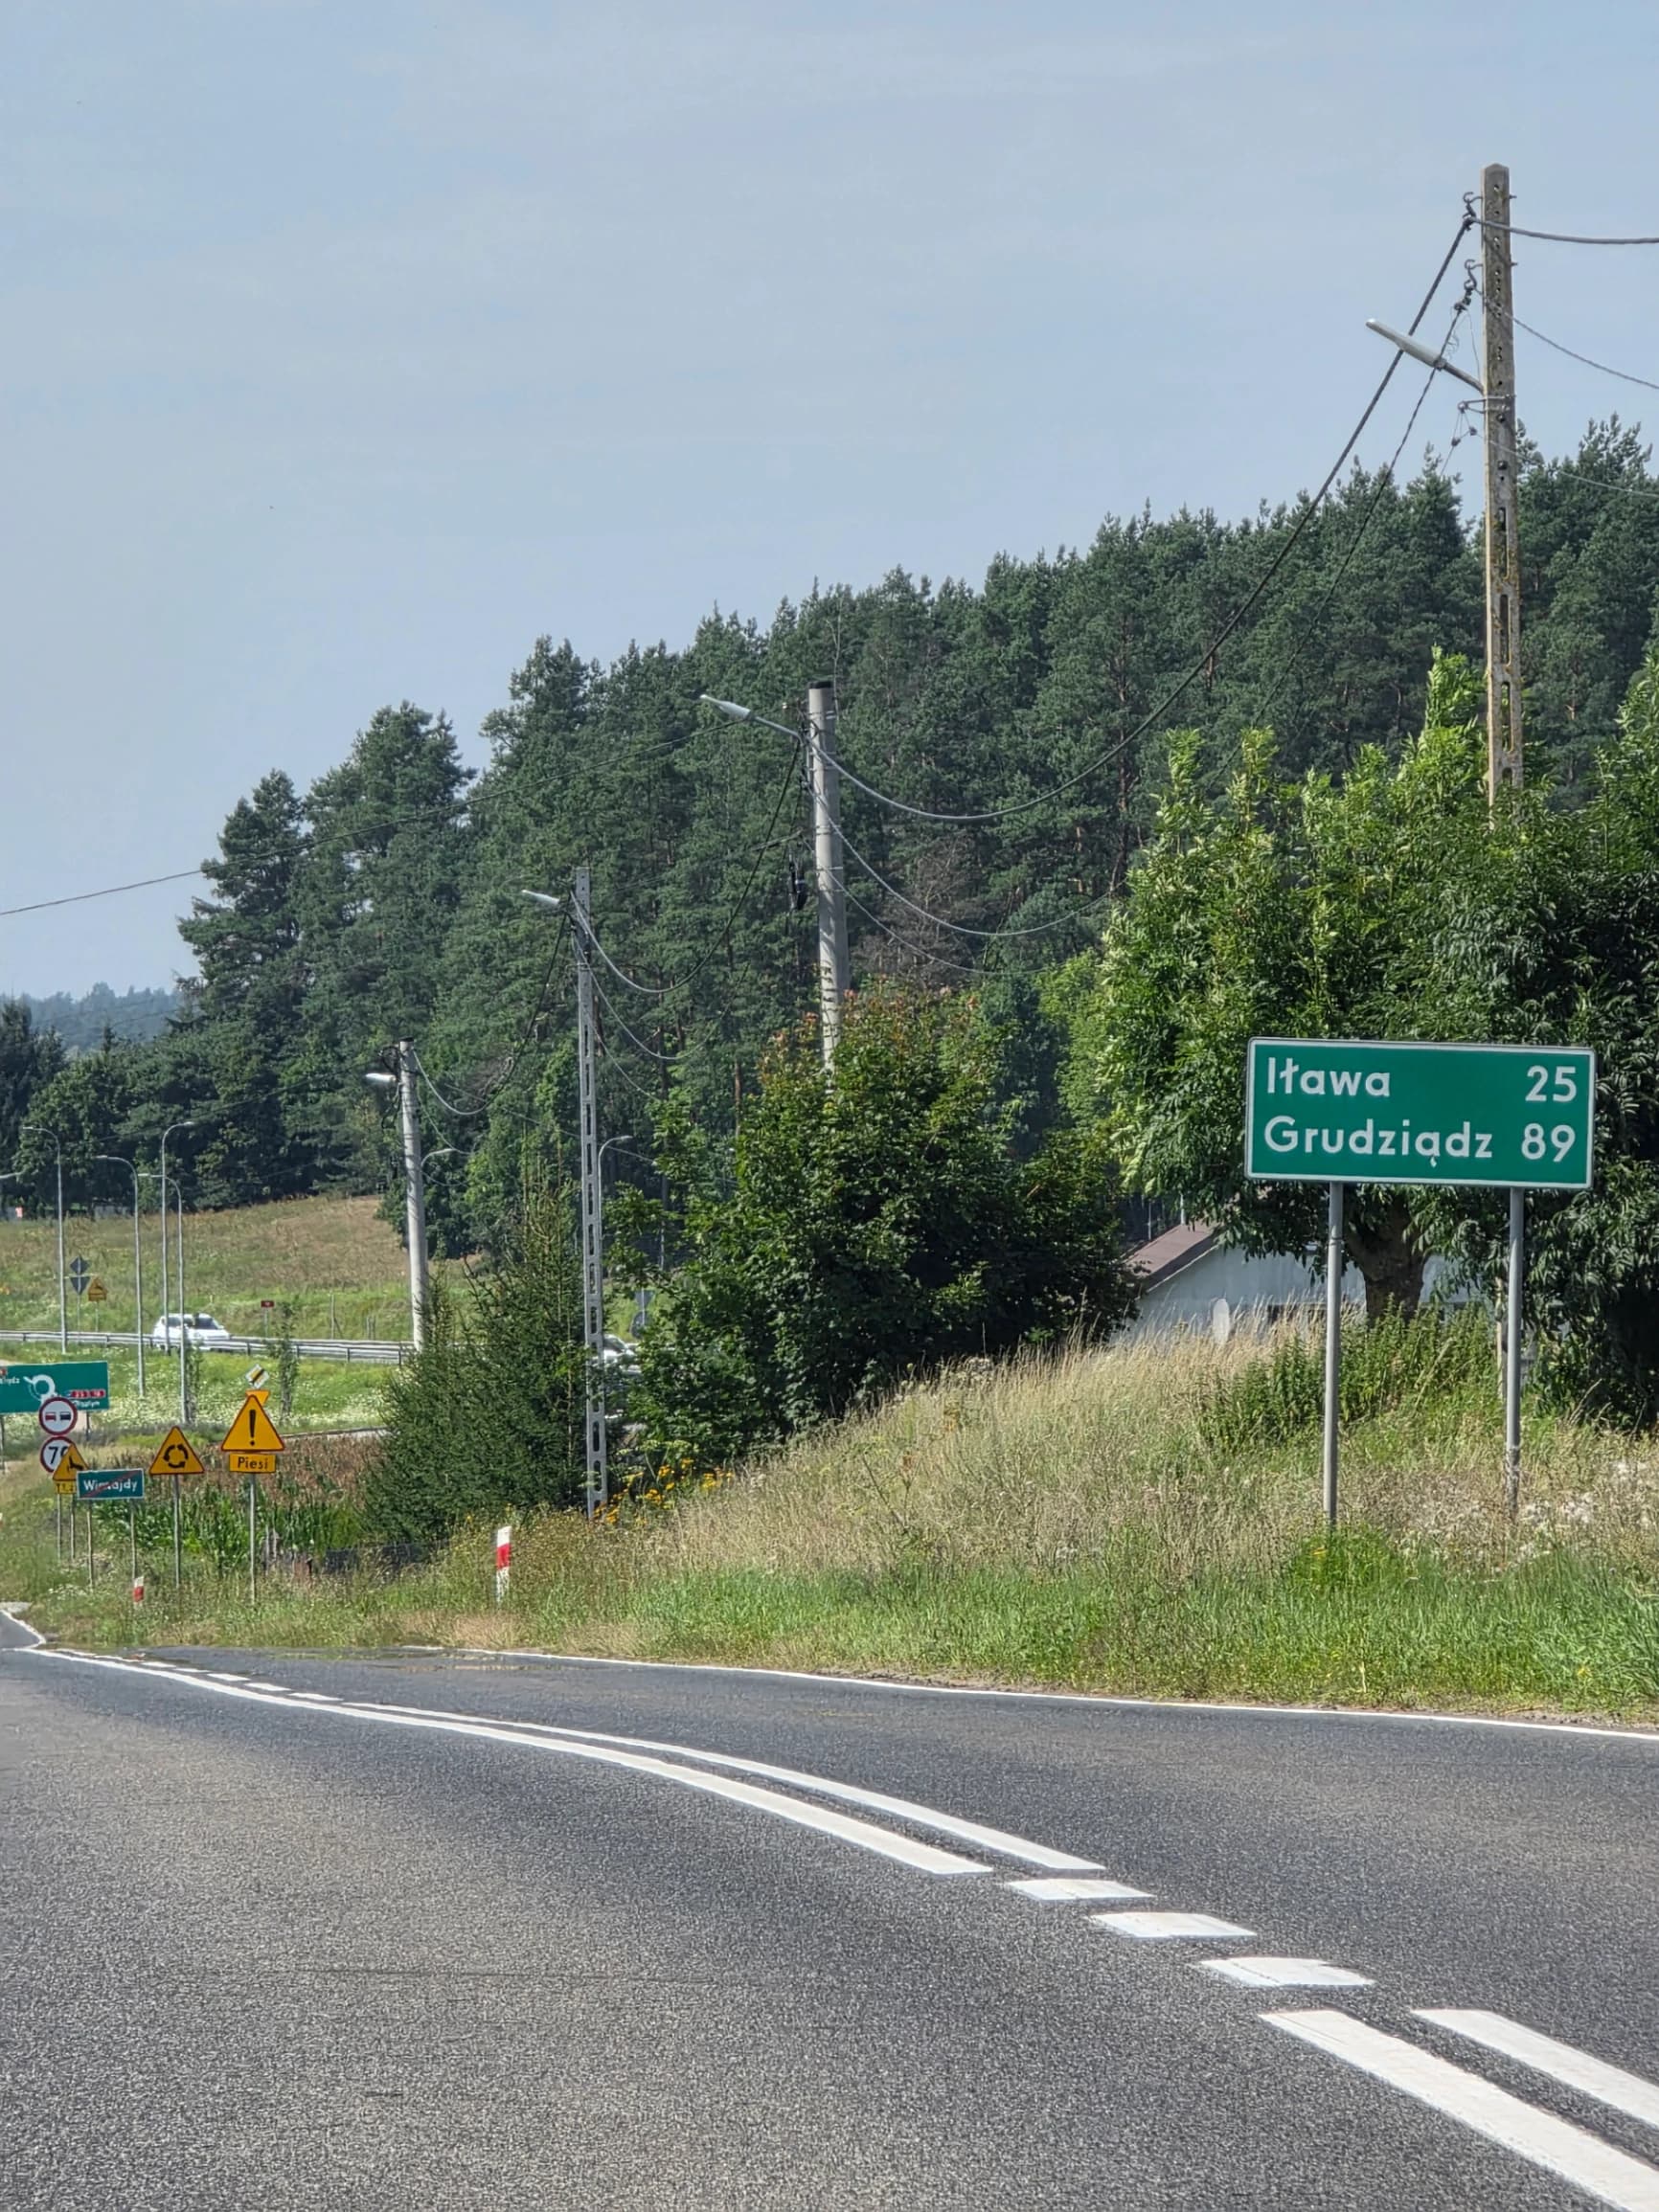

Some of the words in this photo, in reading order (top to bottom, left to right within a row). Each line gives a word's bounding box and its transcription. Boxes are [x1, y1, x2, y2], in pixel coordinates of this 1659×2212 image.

[1266, 1056, 1391, 1097] Iława
[1525, 1065, 1578, 1102] 25
[1263, 1115, 1492, 1168] Grudziądz
[1521, 1123, 1576, 1162] 89
[237, 1456, 268, 1470] Piesi
